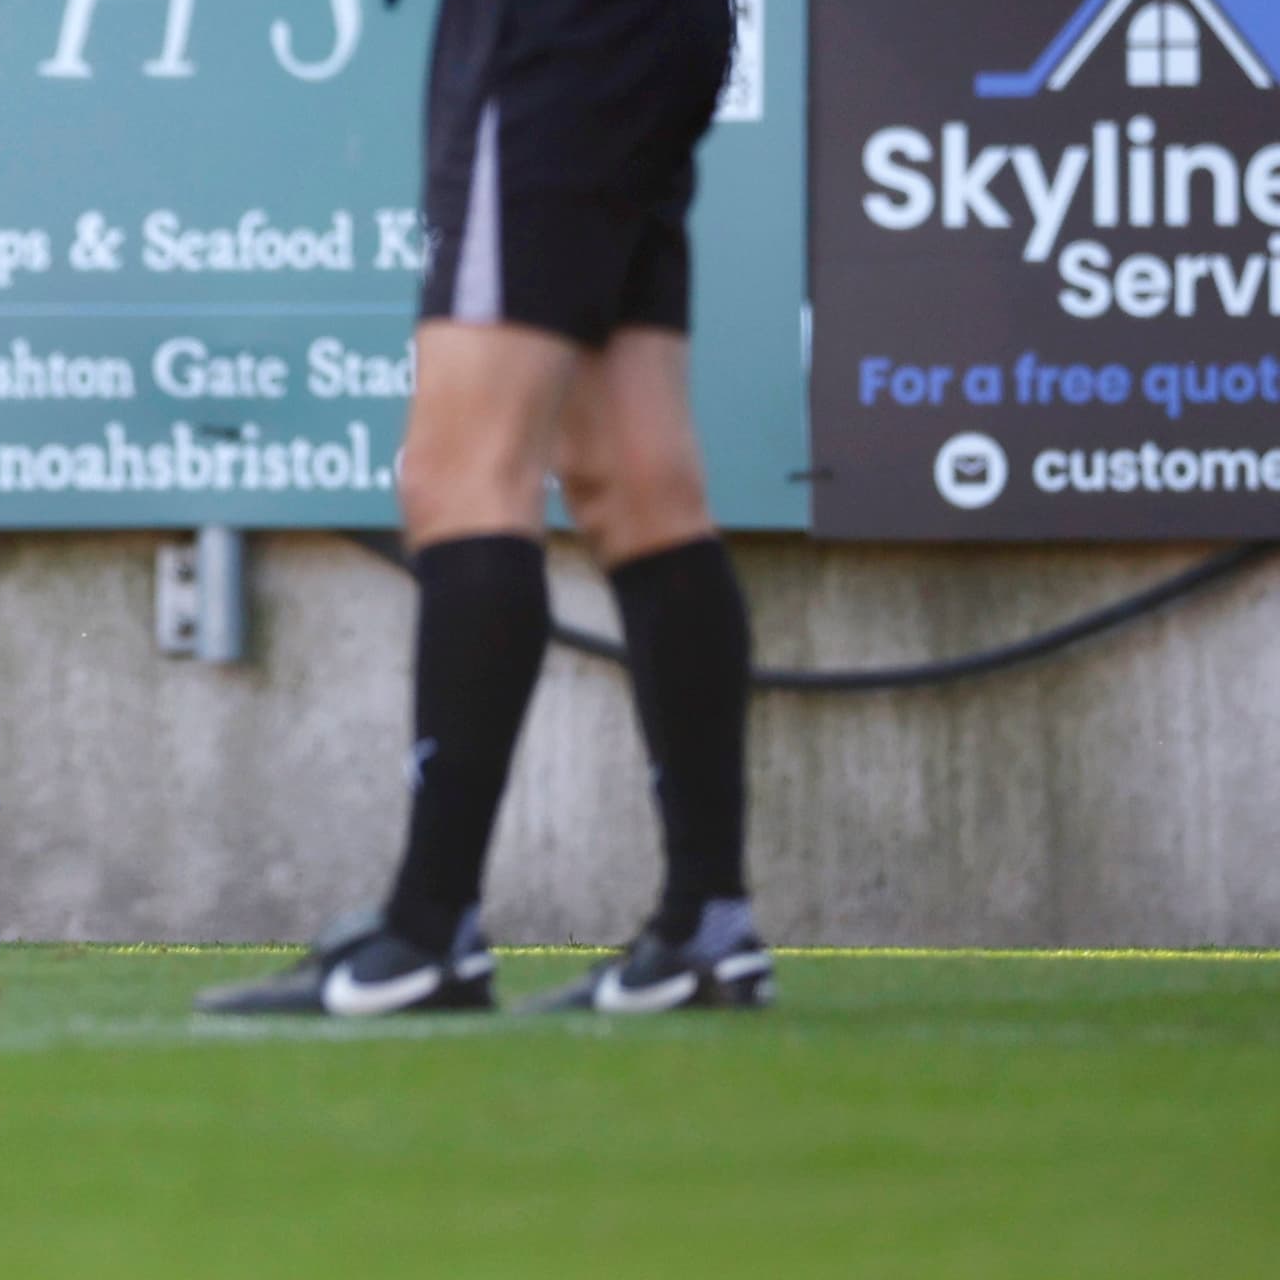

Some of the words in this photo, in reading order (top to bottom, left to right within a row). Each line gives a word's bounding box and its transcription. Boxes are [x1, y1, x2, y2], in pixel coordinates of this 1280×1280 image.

[68, 211, 126, 272] &
[142, 209, 353, 272] Seafood
[151, 336, 288, 399] Gate
[858, 355, 953, 408] For
[962, 363, 1003, 407] a
[1013, 350, 1132, 407] free
[1142, 352, 1280, 420] quot
